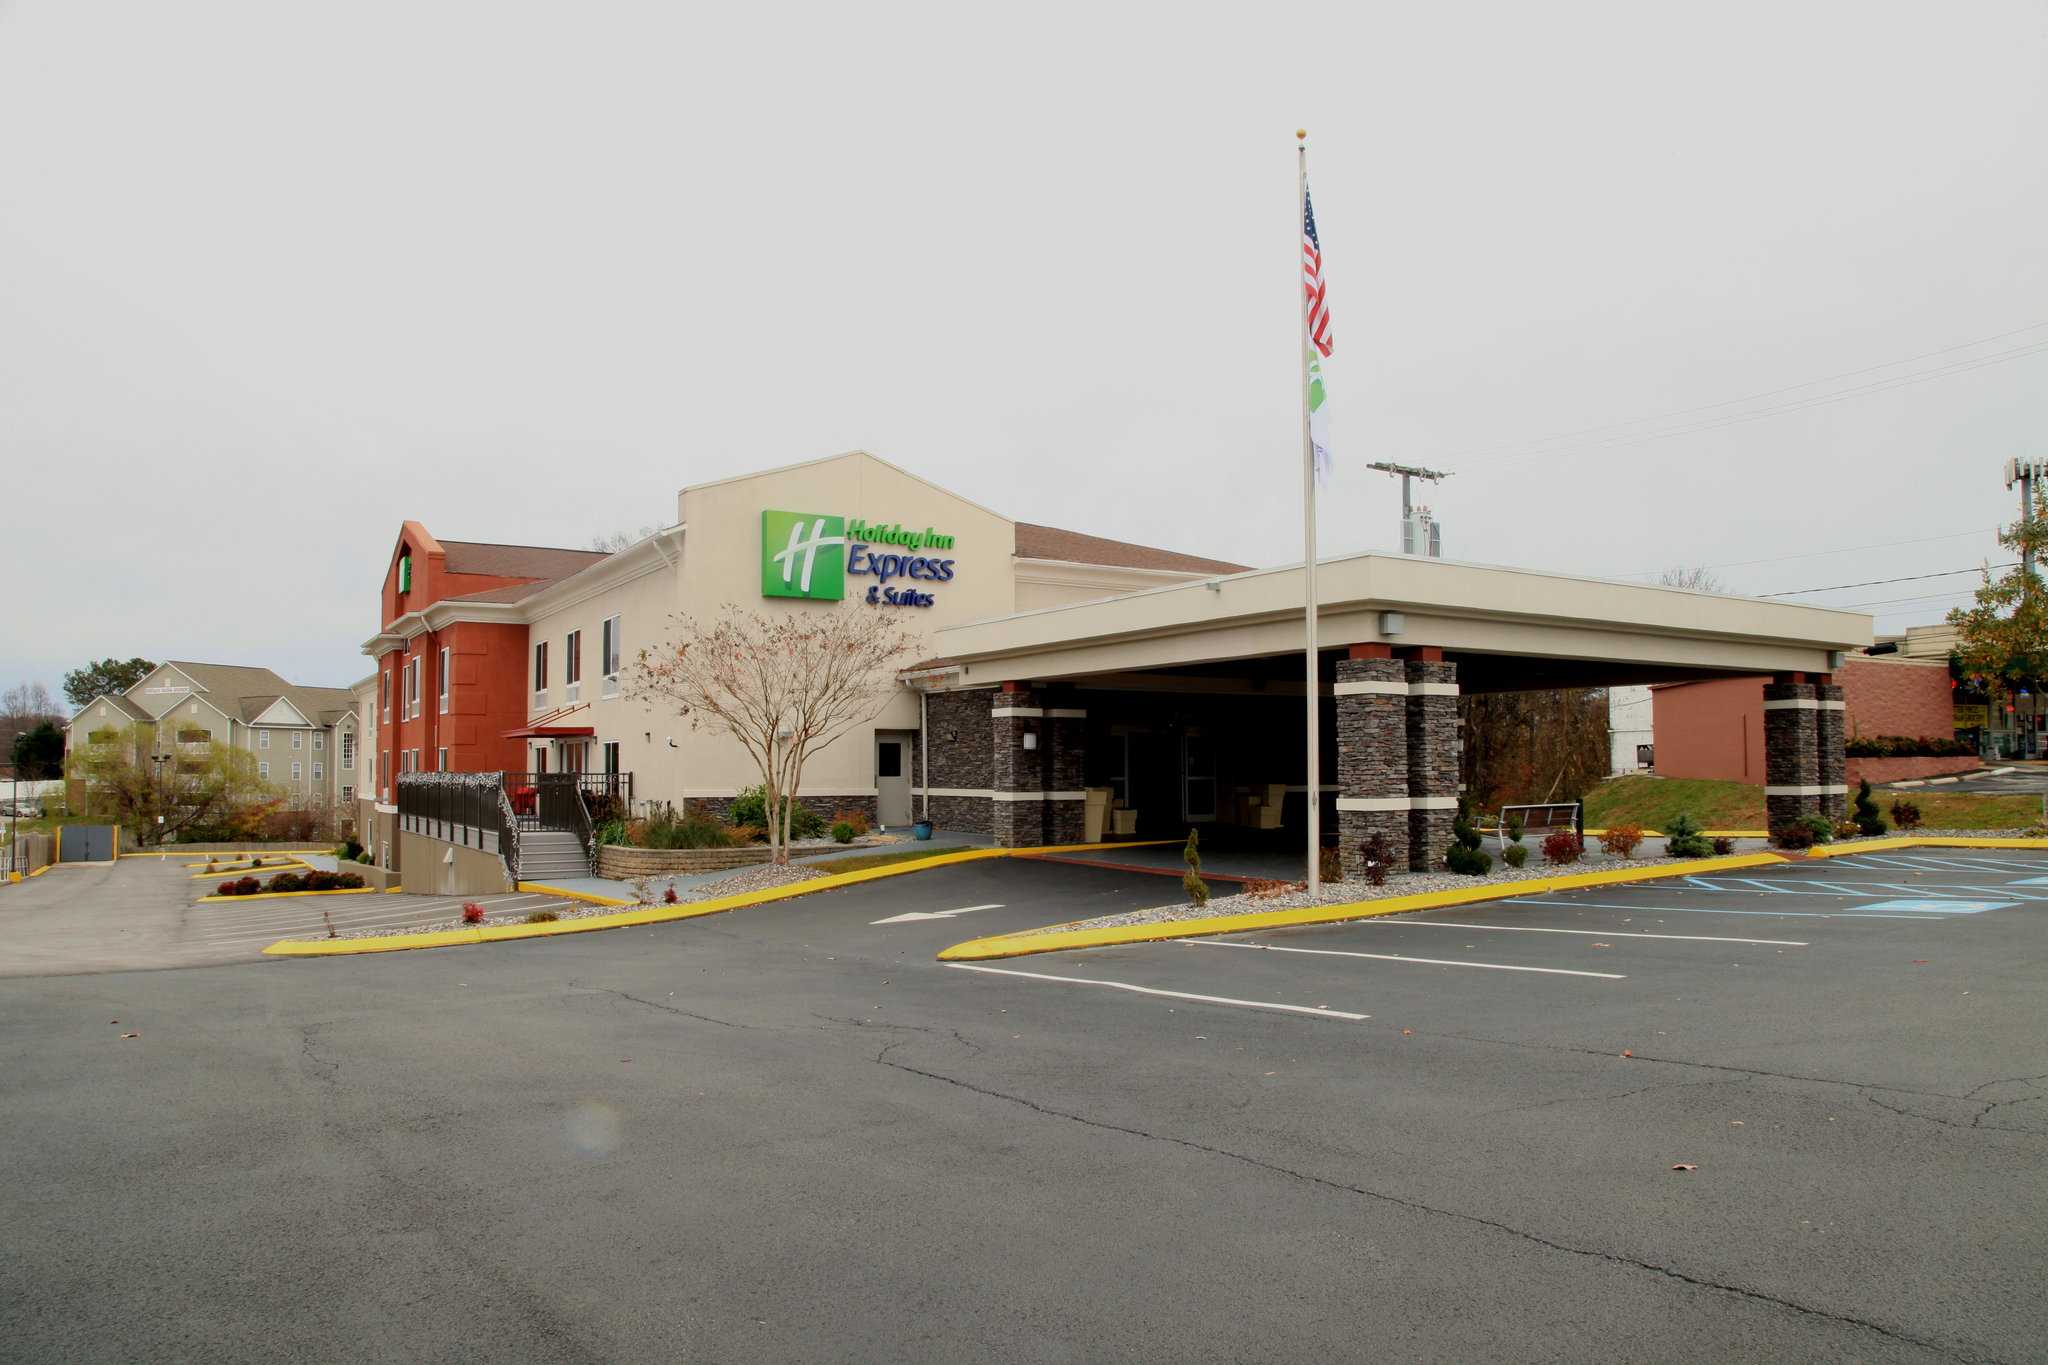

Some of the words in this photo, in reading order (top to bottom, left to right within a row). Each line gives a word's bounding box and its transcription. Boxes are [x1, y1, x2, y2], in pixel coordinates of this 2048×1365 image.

[847, 519, 923, 551] Holiday
[923, 527, 955, 550] Inn
[773, 518, 844, 592] H
[847, 544, 955, 584] Express
[865, 585, 880, 604] &
[881, 586, 935, 607] Suites
